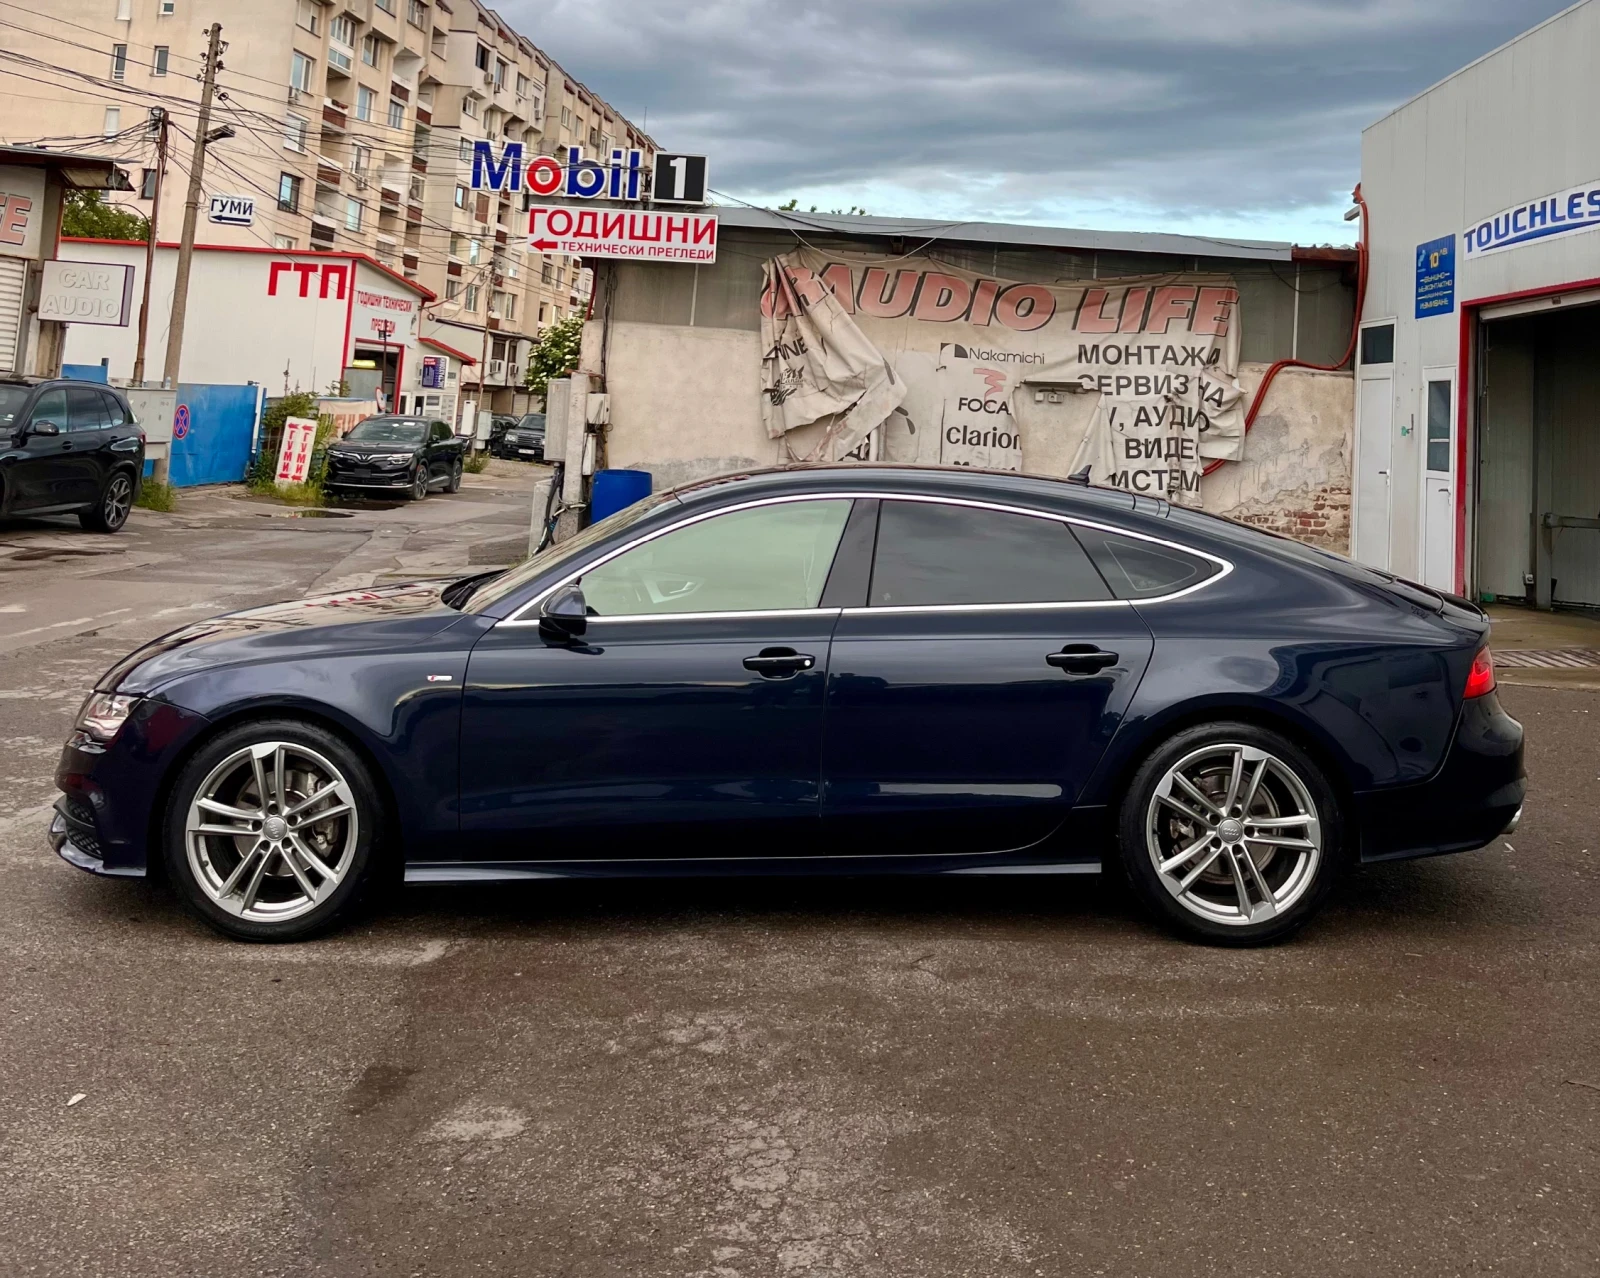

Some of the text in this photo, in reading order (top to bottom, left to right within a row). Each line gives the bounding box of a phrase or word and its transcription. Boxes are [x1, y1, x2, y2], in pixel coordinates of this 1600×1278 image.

[471, 140, 688, 201] Mobil 1
[210, 198, 253, 216] ГУМИ
[528, 207, 717, 246] ГОДИШНИ
[1463, 189, 1600, 254] TOUCHLES
[560, 240, 715, 261] ТЕХНИЧЕСКИ ПРЕГЛЕДИ
[59, 268, 110, 291] CAR
[268, 261, 348, 300] ГТП
[42, 294, 120, 319] AUDIO
[1073, 284, 1241, 338] LIFE
[371, 317, 396, 334] ПРЕГЕДИ
[969, 346, 1046, 365] Nakamichi
[1077, 343, 1207, 367] МОНТАЖ
[958, 396, 1012, 416] FOCA
[282, 430, 296, 472] ГУМИ
[295, 432, 310, 474] ГУМИ
[1125, 436, 1199, 462] ВИДЕ
